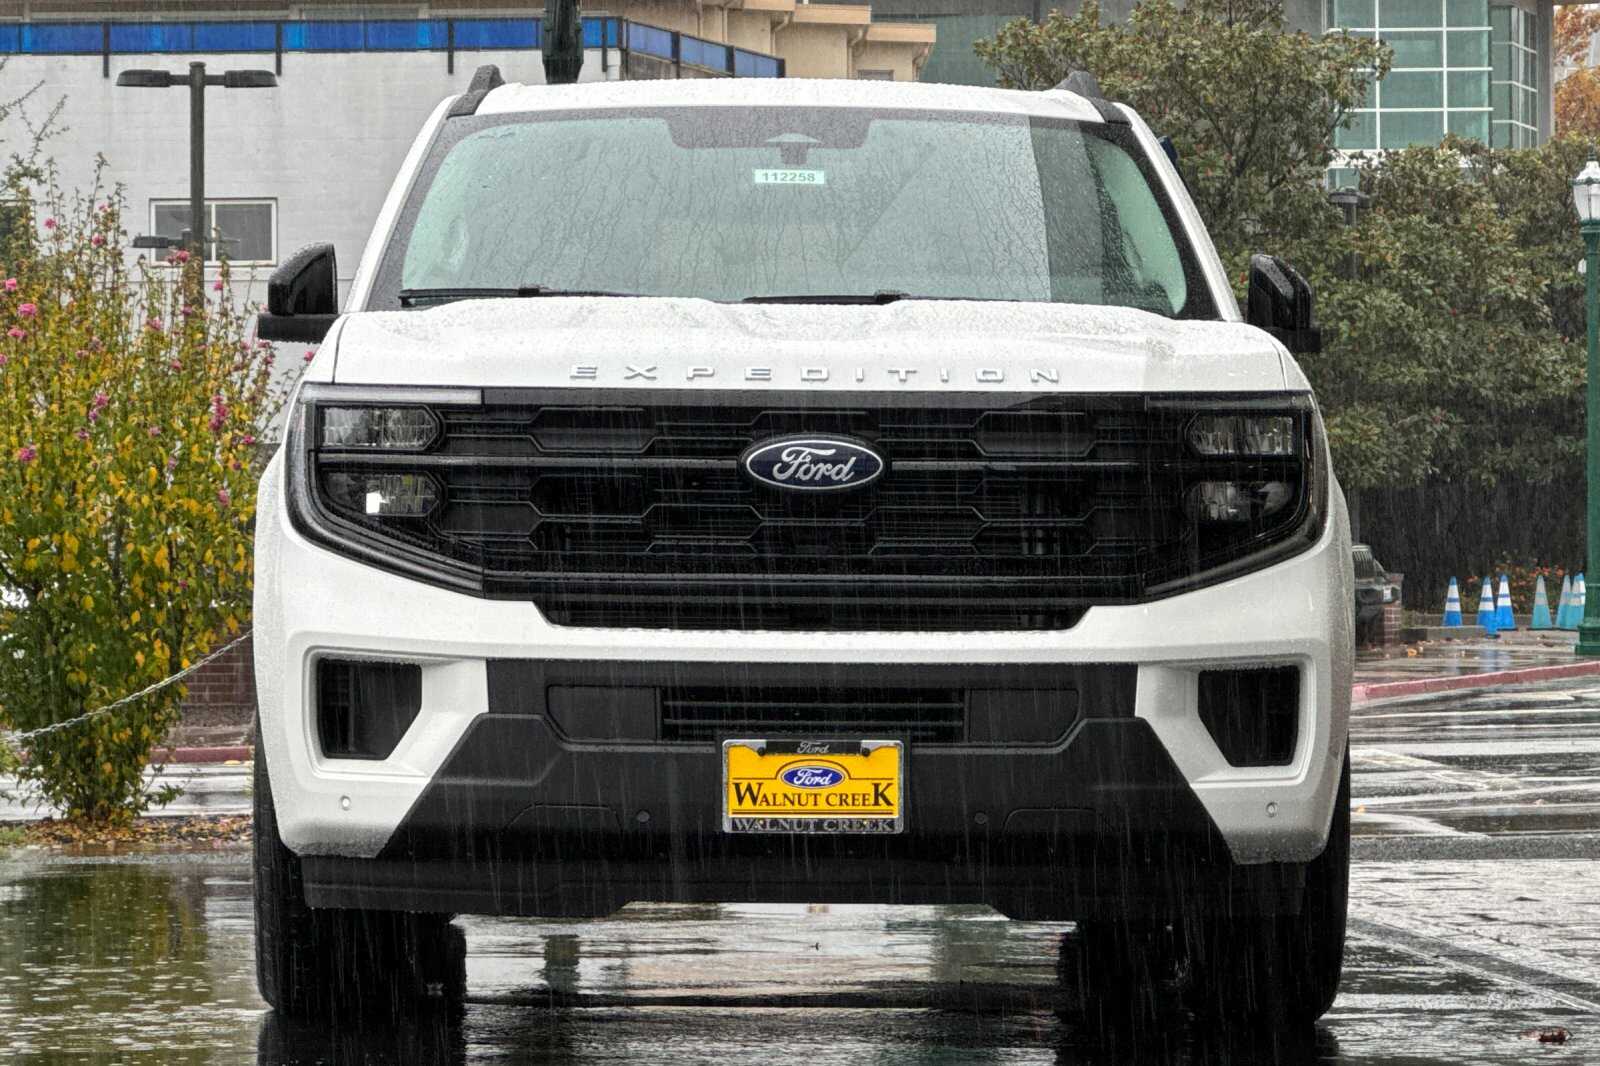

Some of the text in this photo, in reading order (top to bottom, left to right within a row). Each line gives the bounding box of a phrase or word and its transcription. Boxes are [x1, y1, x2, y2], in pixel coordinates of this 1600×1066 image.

[762, 173, 816, 182] 112258
[569, 365, 1060, 384] EXPEDITION
[772, 445, 858, 483] Ford
[797, 741, 830, 754] Ford
[793, 768, 833, 786] Ford
[733, 782, 894, 807] WALNUT CREEK
[734, 818, 893, 832] WALNUT CREEK
